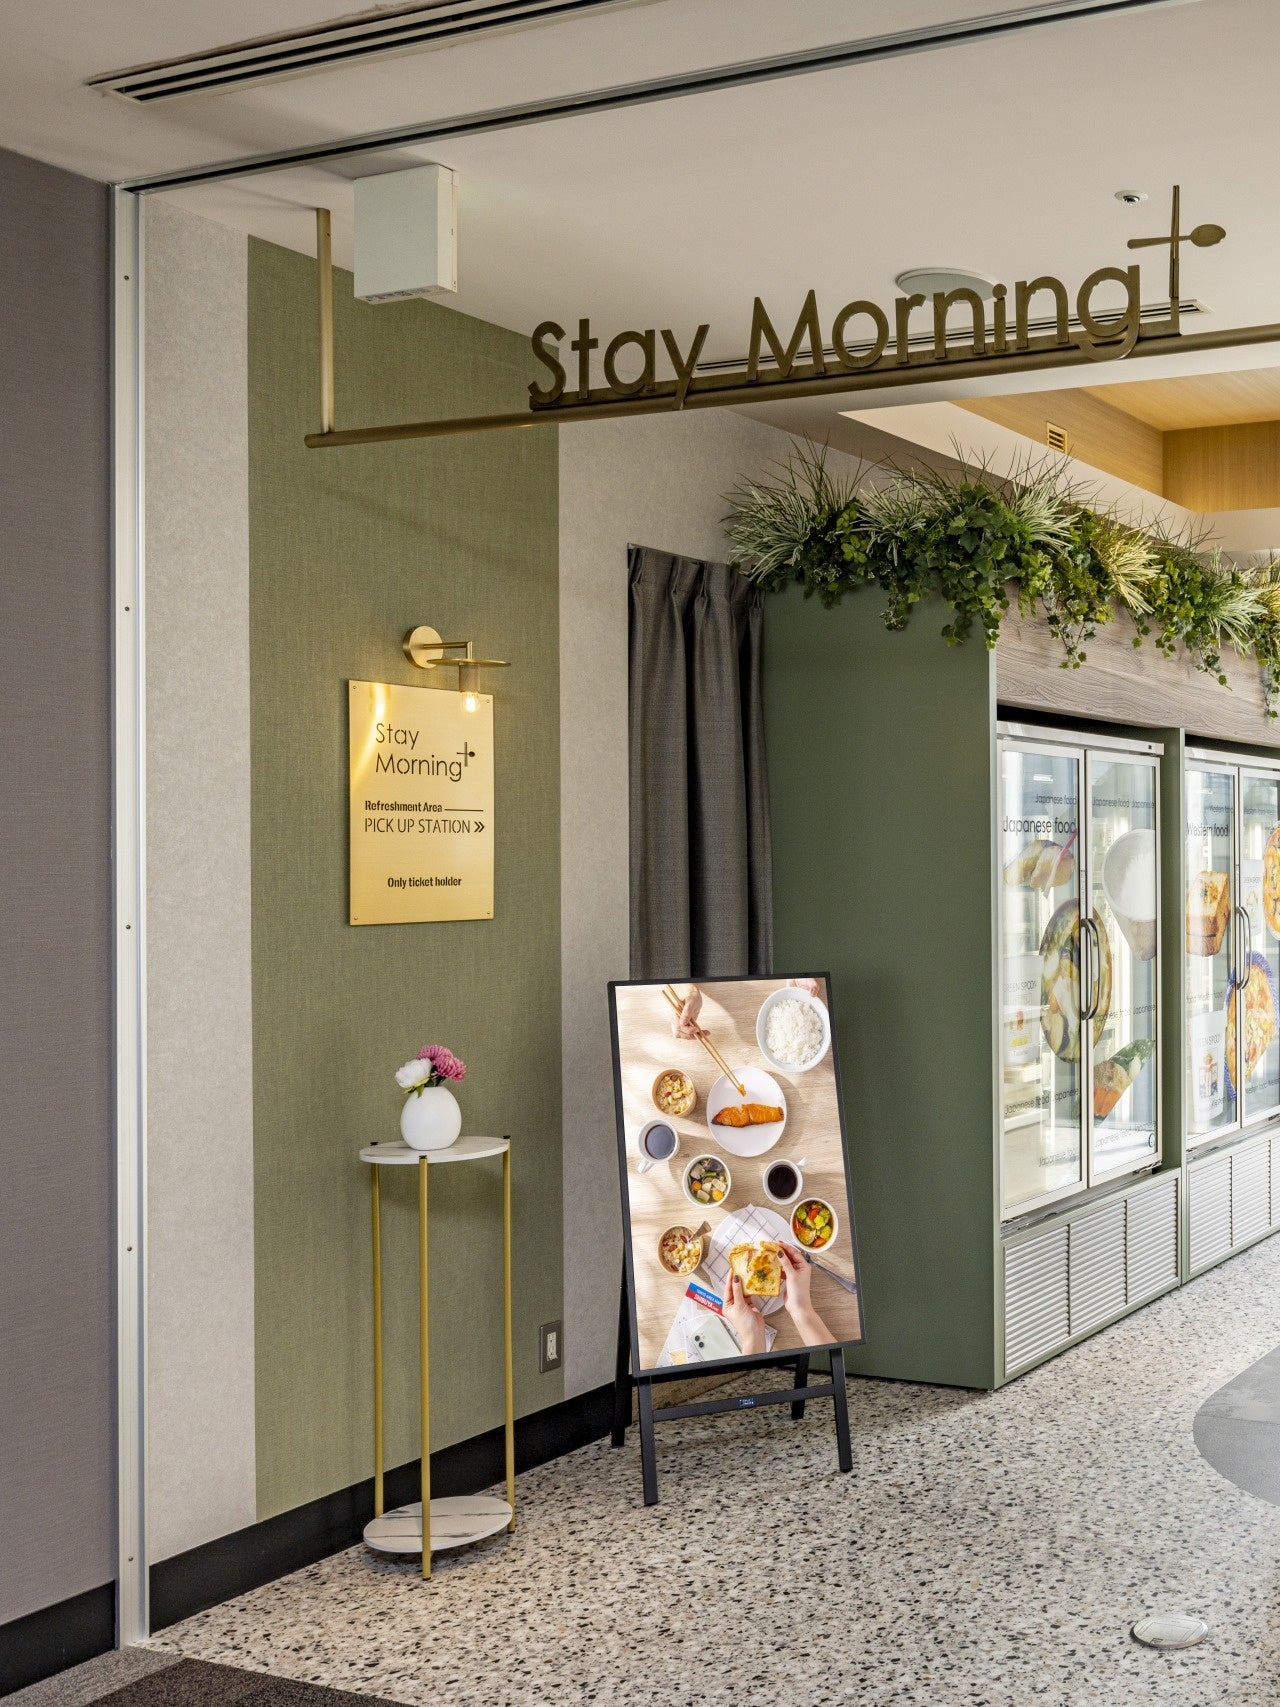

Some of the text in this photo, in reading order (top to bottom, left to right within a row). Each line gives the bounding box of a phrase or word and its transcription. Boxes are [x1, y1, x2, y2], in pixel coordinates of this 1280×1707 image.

[528, 264, 1141, 411] Stay Morning
[375, 722, 420, 751] Stay
[375, 752, 462, 783] Morning
[365, 800, 443, 813] Refreshment Area
[364, 817, 471, 834] PICK UP STATION
[1003, 816, 1077, 836] Japanese food
[1213, 823, 1230, 837] food
[387, 876, 462, 890] Only ticket holder
